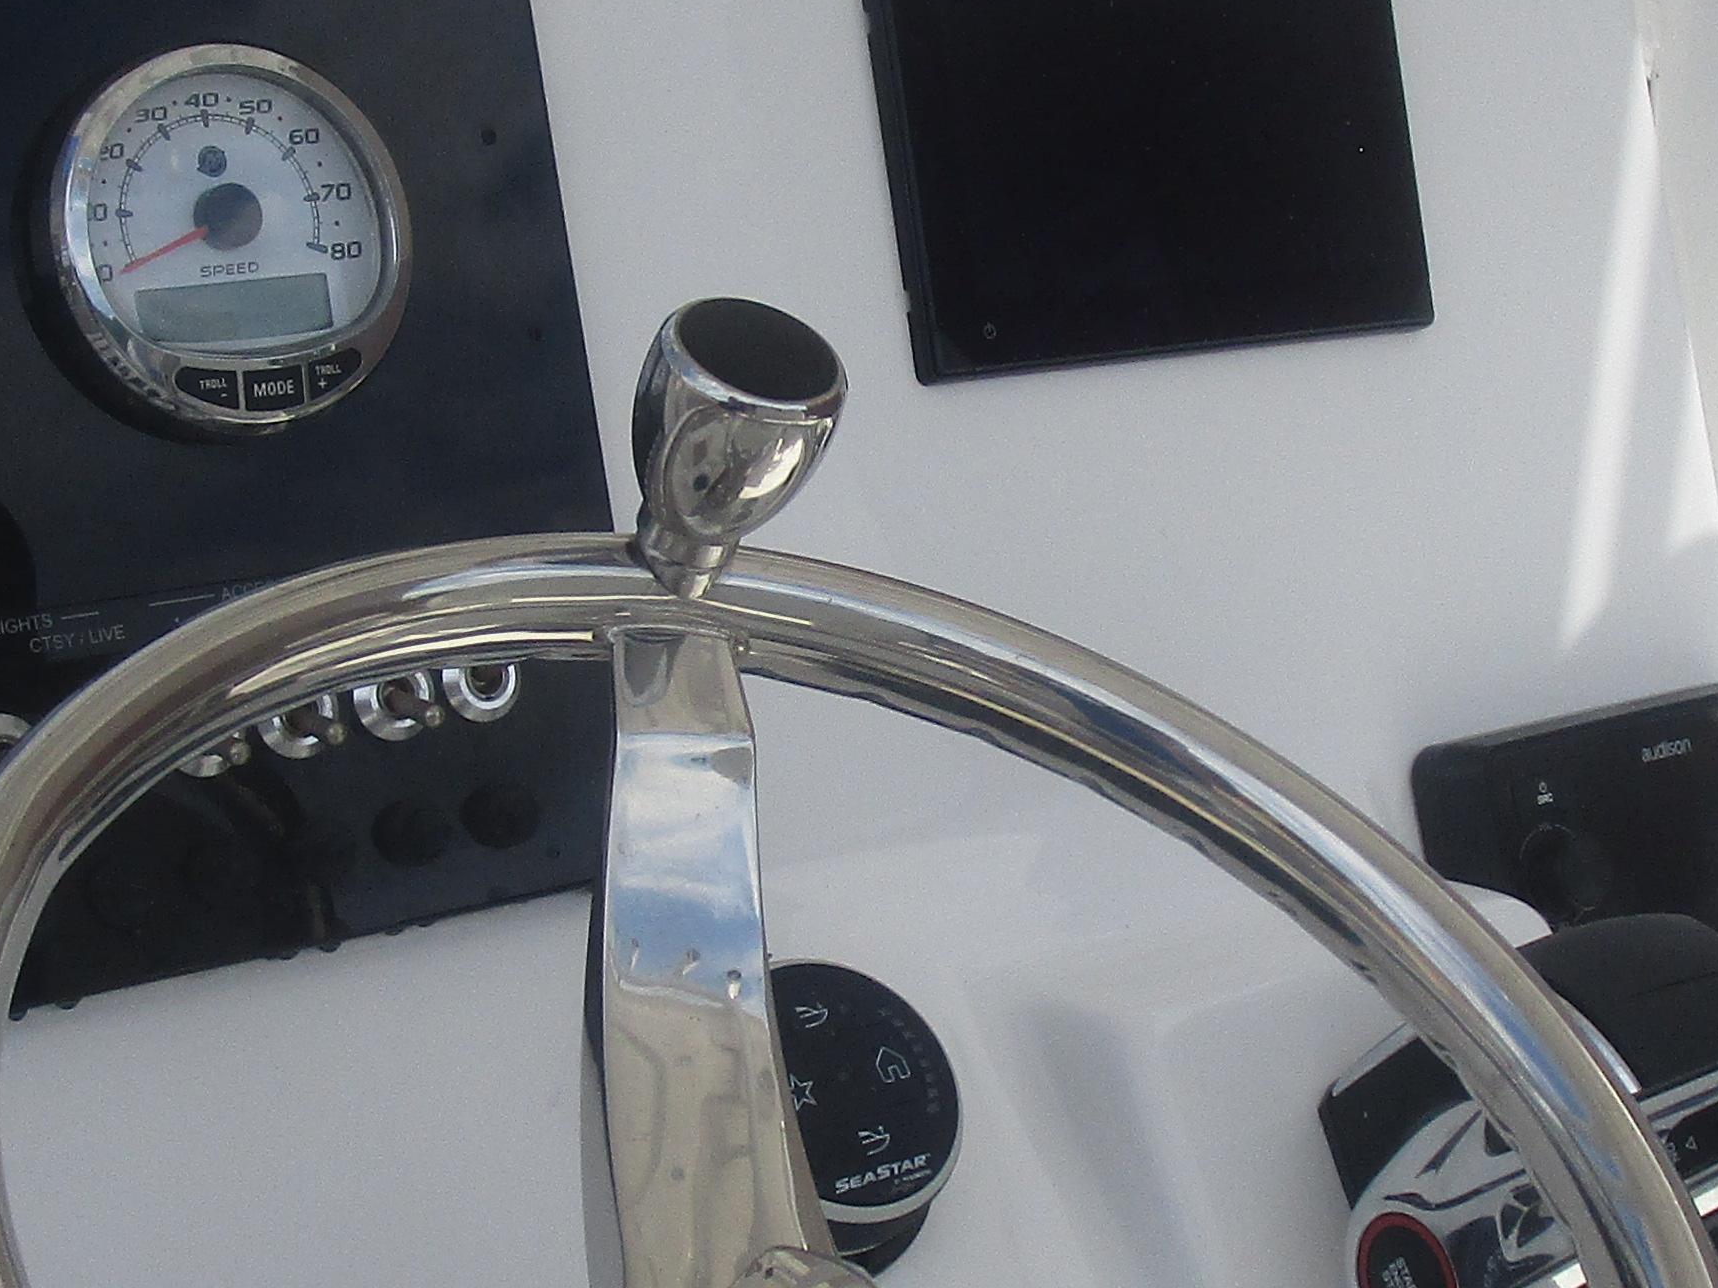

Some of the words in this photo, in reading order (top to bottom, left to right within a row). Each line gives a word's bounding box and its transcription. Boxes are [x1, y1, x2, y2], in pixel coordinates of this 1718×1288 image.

[184, 91, 220, 109] 40
[238, 98, 273, 115] 50
[134, 105, 168, 124] 30
[288, 127, 320, 145] 60
[320, 183, 352, 202] 70
[330, 241, 363, 260] 80
[199, 260, 260, 279] SPEED
[253, 377, 296, 398] MODE
[29, 632, 75, 654] CTSY
[88, 624, 126, 645] LIVE
[1641, 736, 1693, 764] audison
